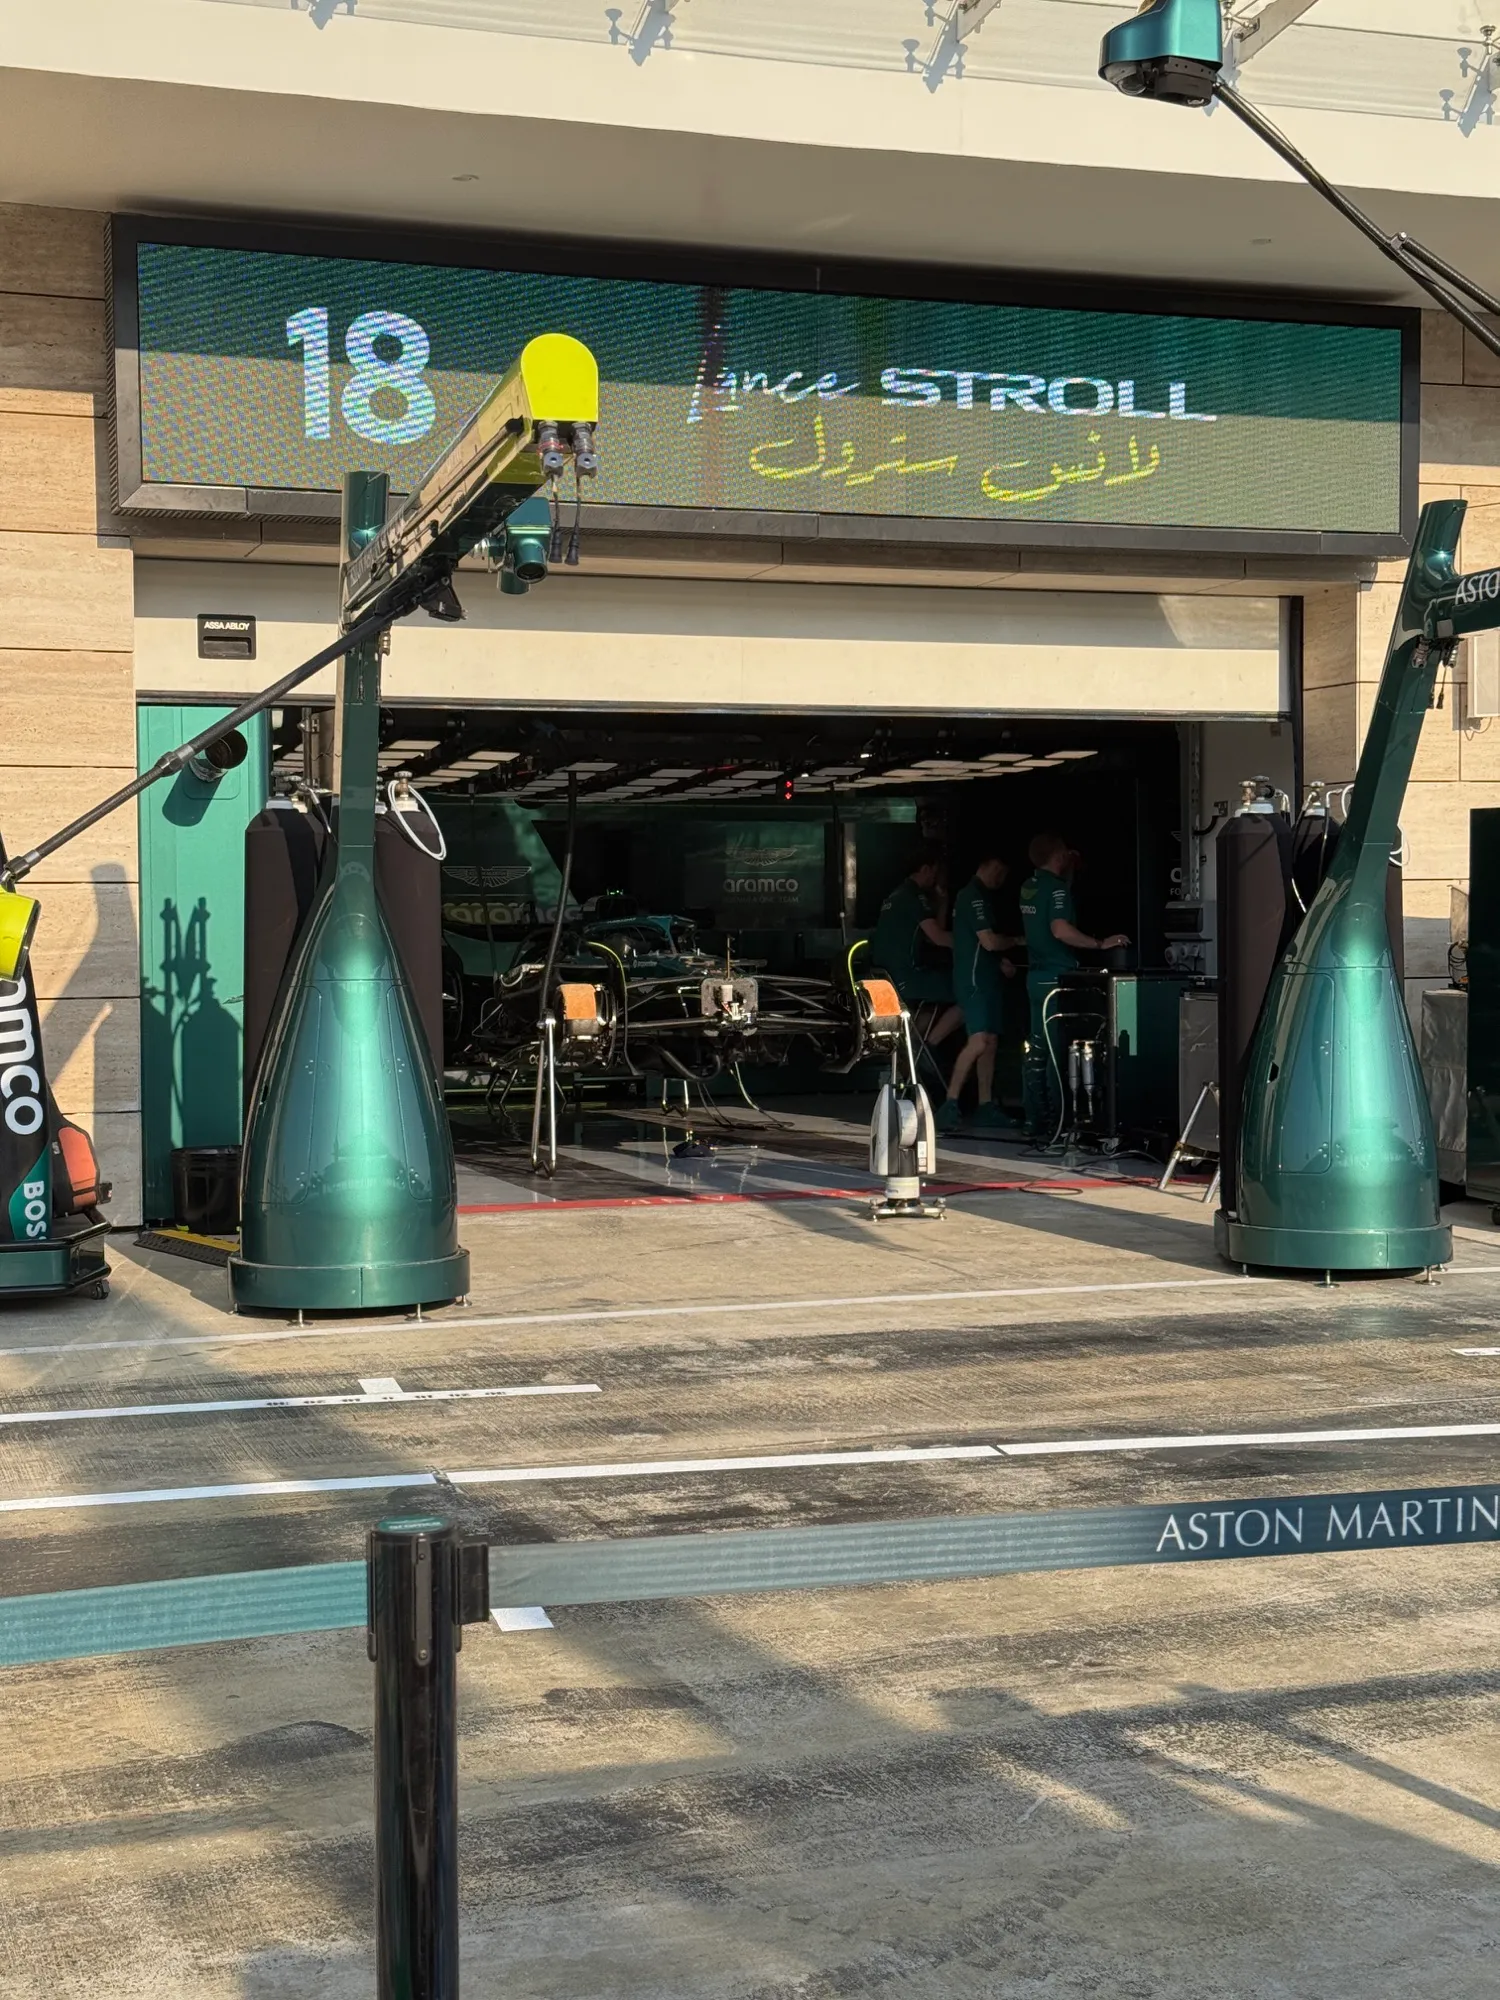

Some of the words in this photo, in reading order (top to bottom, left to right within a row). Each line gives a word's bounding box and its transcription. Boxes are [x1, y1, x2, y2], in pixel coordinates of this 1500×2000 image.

[286, 307, 436, 445] 18
[881, 367, 1217, 422] STROLL
[204, 621, 224, 630] ASSA
[225, 622, 250, 631] ABLOY
[723, 878, 799, 893] aramco
[24, 1181, 47, 1239] BOS
[1156, 1507, 1303, 1552] ASTON
[1326, 1495, 1500, 1541] MARTIN
